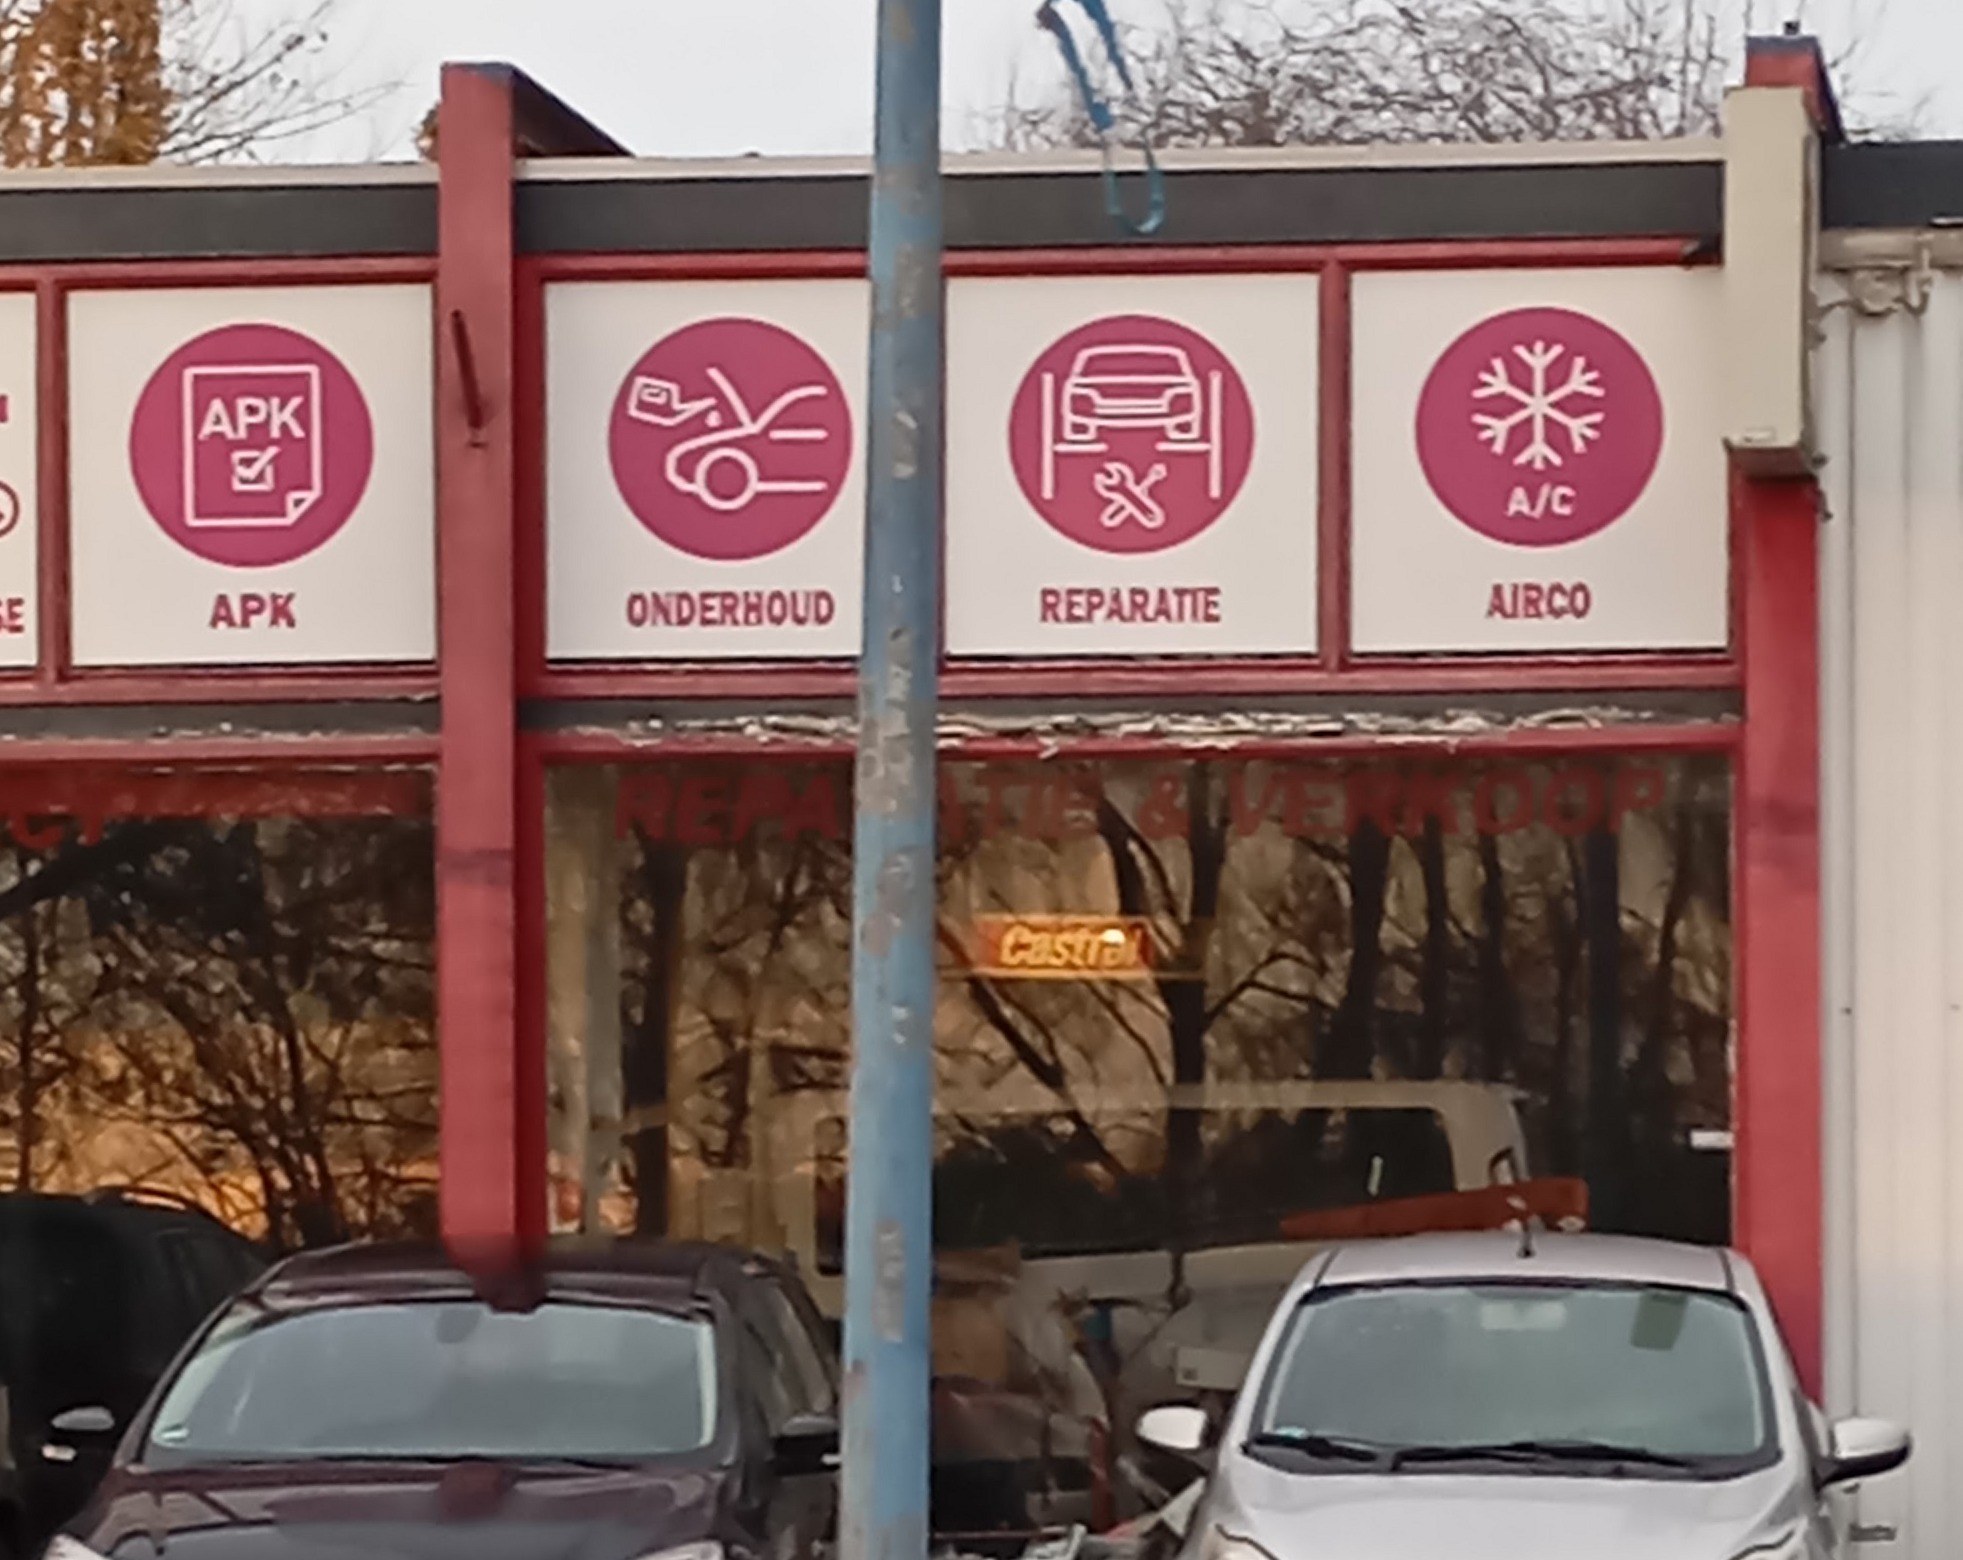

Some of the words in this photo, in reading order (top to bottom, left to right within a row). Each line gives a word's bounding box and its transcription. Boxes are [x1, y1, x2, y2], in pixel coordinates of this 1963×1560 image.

[198, 396, 305, 440] APK
[1504, 482, 1576, 519] A/C
[209, 592, 296, 629] APK
[626, 590, 835, 627] ONDERHOUD
[1039, 586, 1221, 623] REPARATIE
[1486, 582, 1591, 619] AIRCO
[1138, 774, 1191, 838] &
[1229, 768, 1666, 838] VERKOOP
